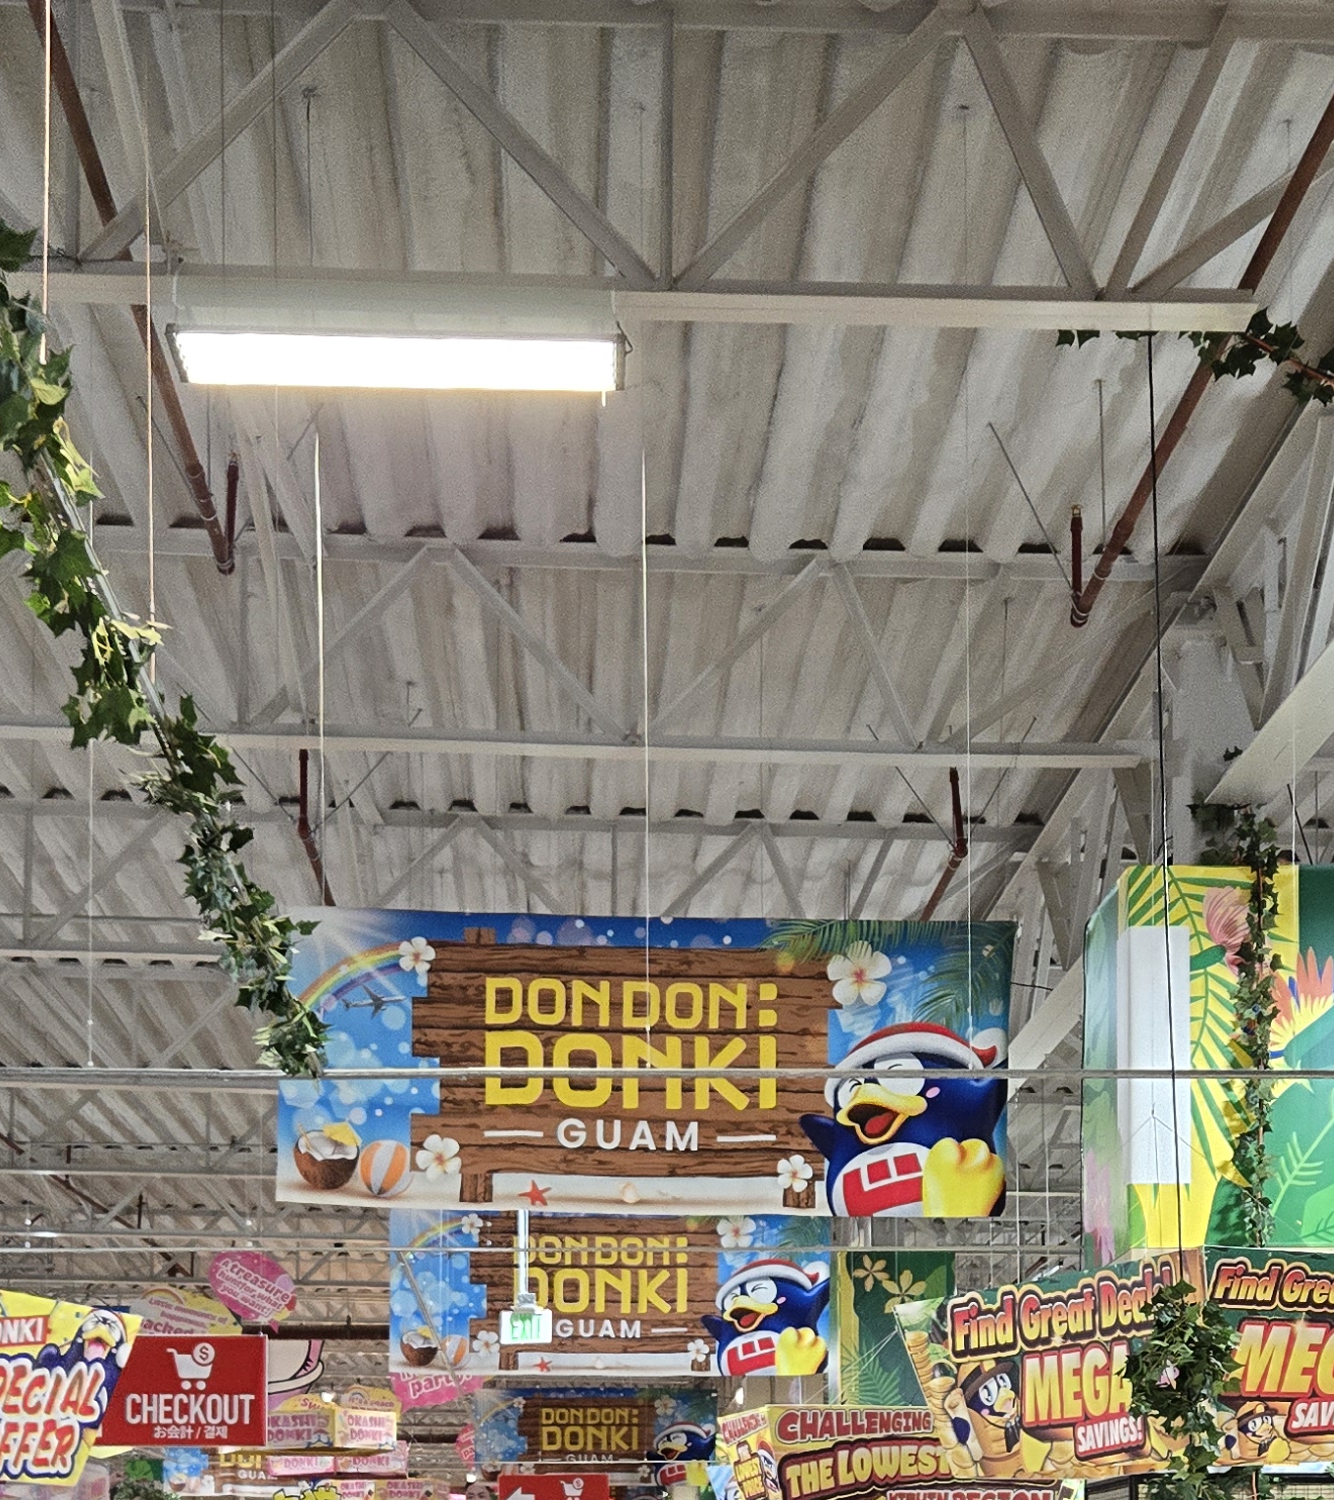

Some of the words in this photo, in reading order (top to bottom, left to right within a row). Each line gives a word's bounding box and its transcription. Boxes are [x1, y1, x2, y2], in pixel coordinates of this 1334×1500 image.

[484, 1029, 778, 1111] DONKI
[556, 1119, 700, 1152] GUAM
[229, 1262, 292, 1304] treasure
[513, 1268, 688, 1314] DONKI
[1214, 1265, 1280, 1301] Find
[555, 1319, 642, 1339] GUAM
[953, 1295, 1014, 1351] Find
[1021, 1288, 1095, 1342] Great
[1025, 1343, 1134, 1424] MEGA
[124, 1393, 256, 1425] CHECKOUT
[776, 1408, 933, 1442] CHALLENGING
[153, 1425, 194, 1440] お会計
[541, 1425, 639, 1451] DONKI
[1075, 1418, 1144, 1453] SAVINGS!
[785, 1458, 835, 1499] THE
[842, 1443, 950, 1488] LOWEST
